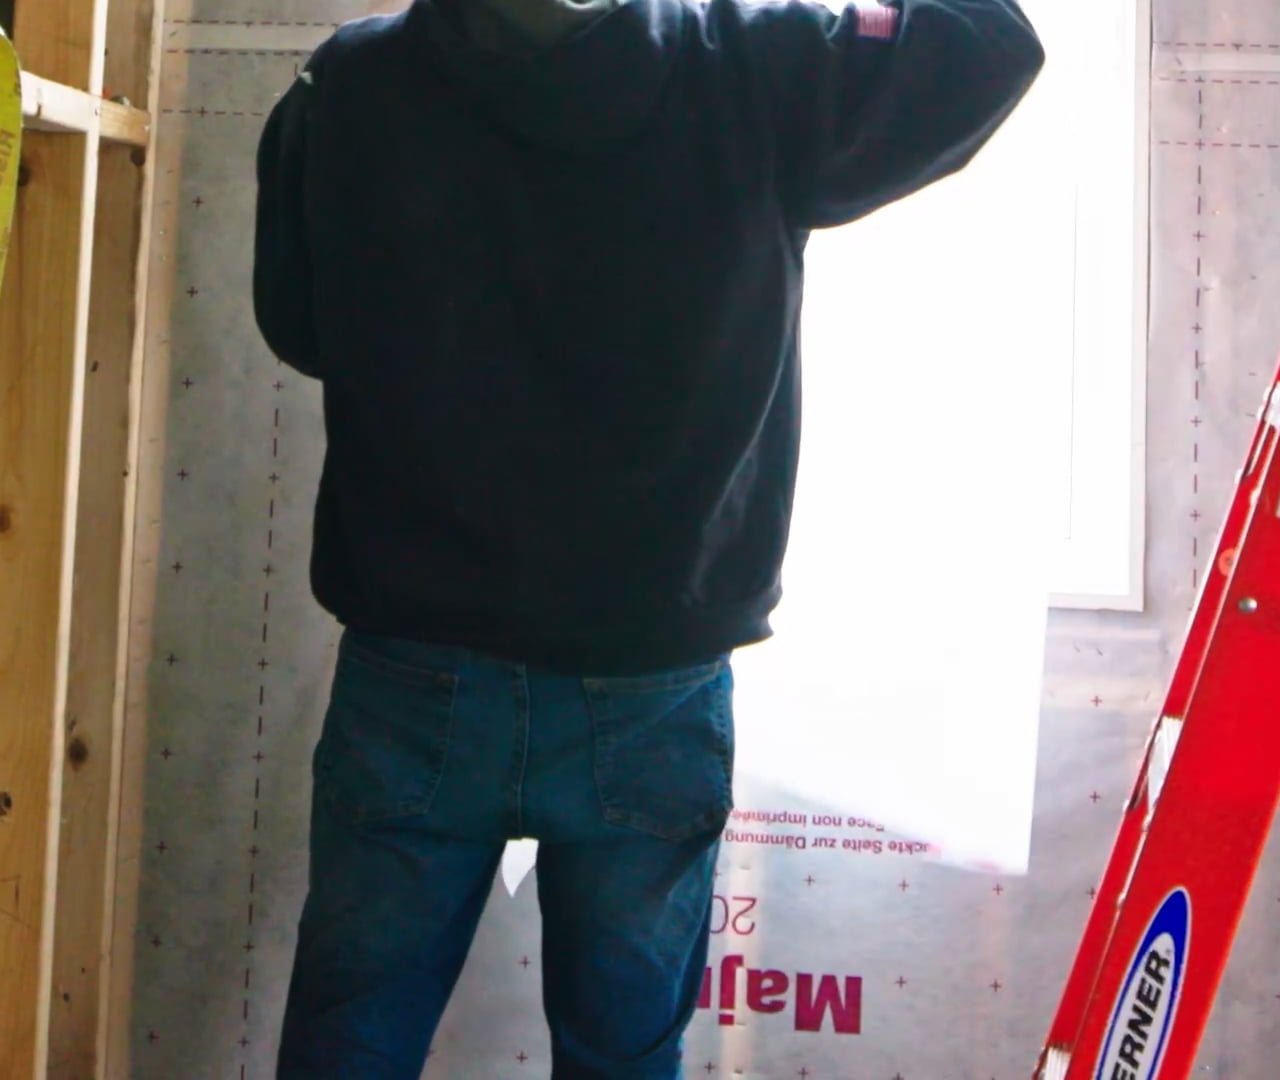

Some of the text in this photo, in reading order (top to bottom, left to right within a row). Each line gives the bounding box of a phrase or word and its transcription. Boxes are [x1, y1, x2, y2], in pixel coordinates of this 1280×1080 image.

[812, 814, 842, 828] non
[725, 832, 806, 851] Dämmung
[812, 836, 837, 849] zur
[842, 840, 882, 854] Seite
